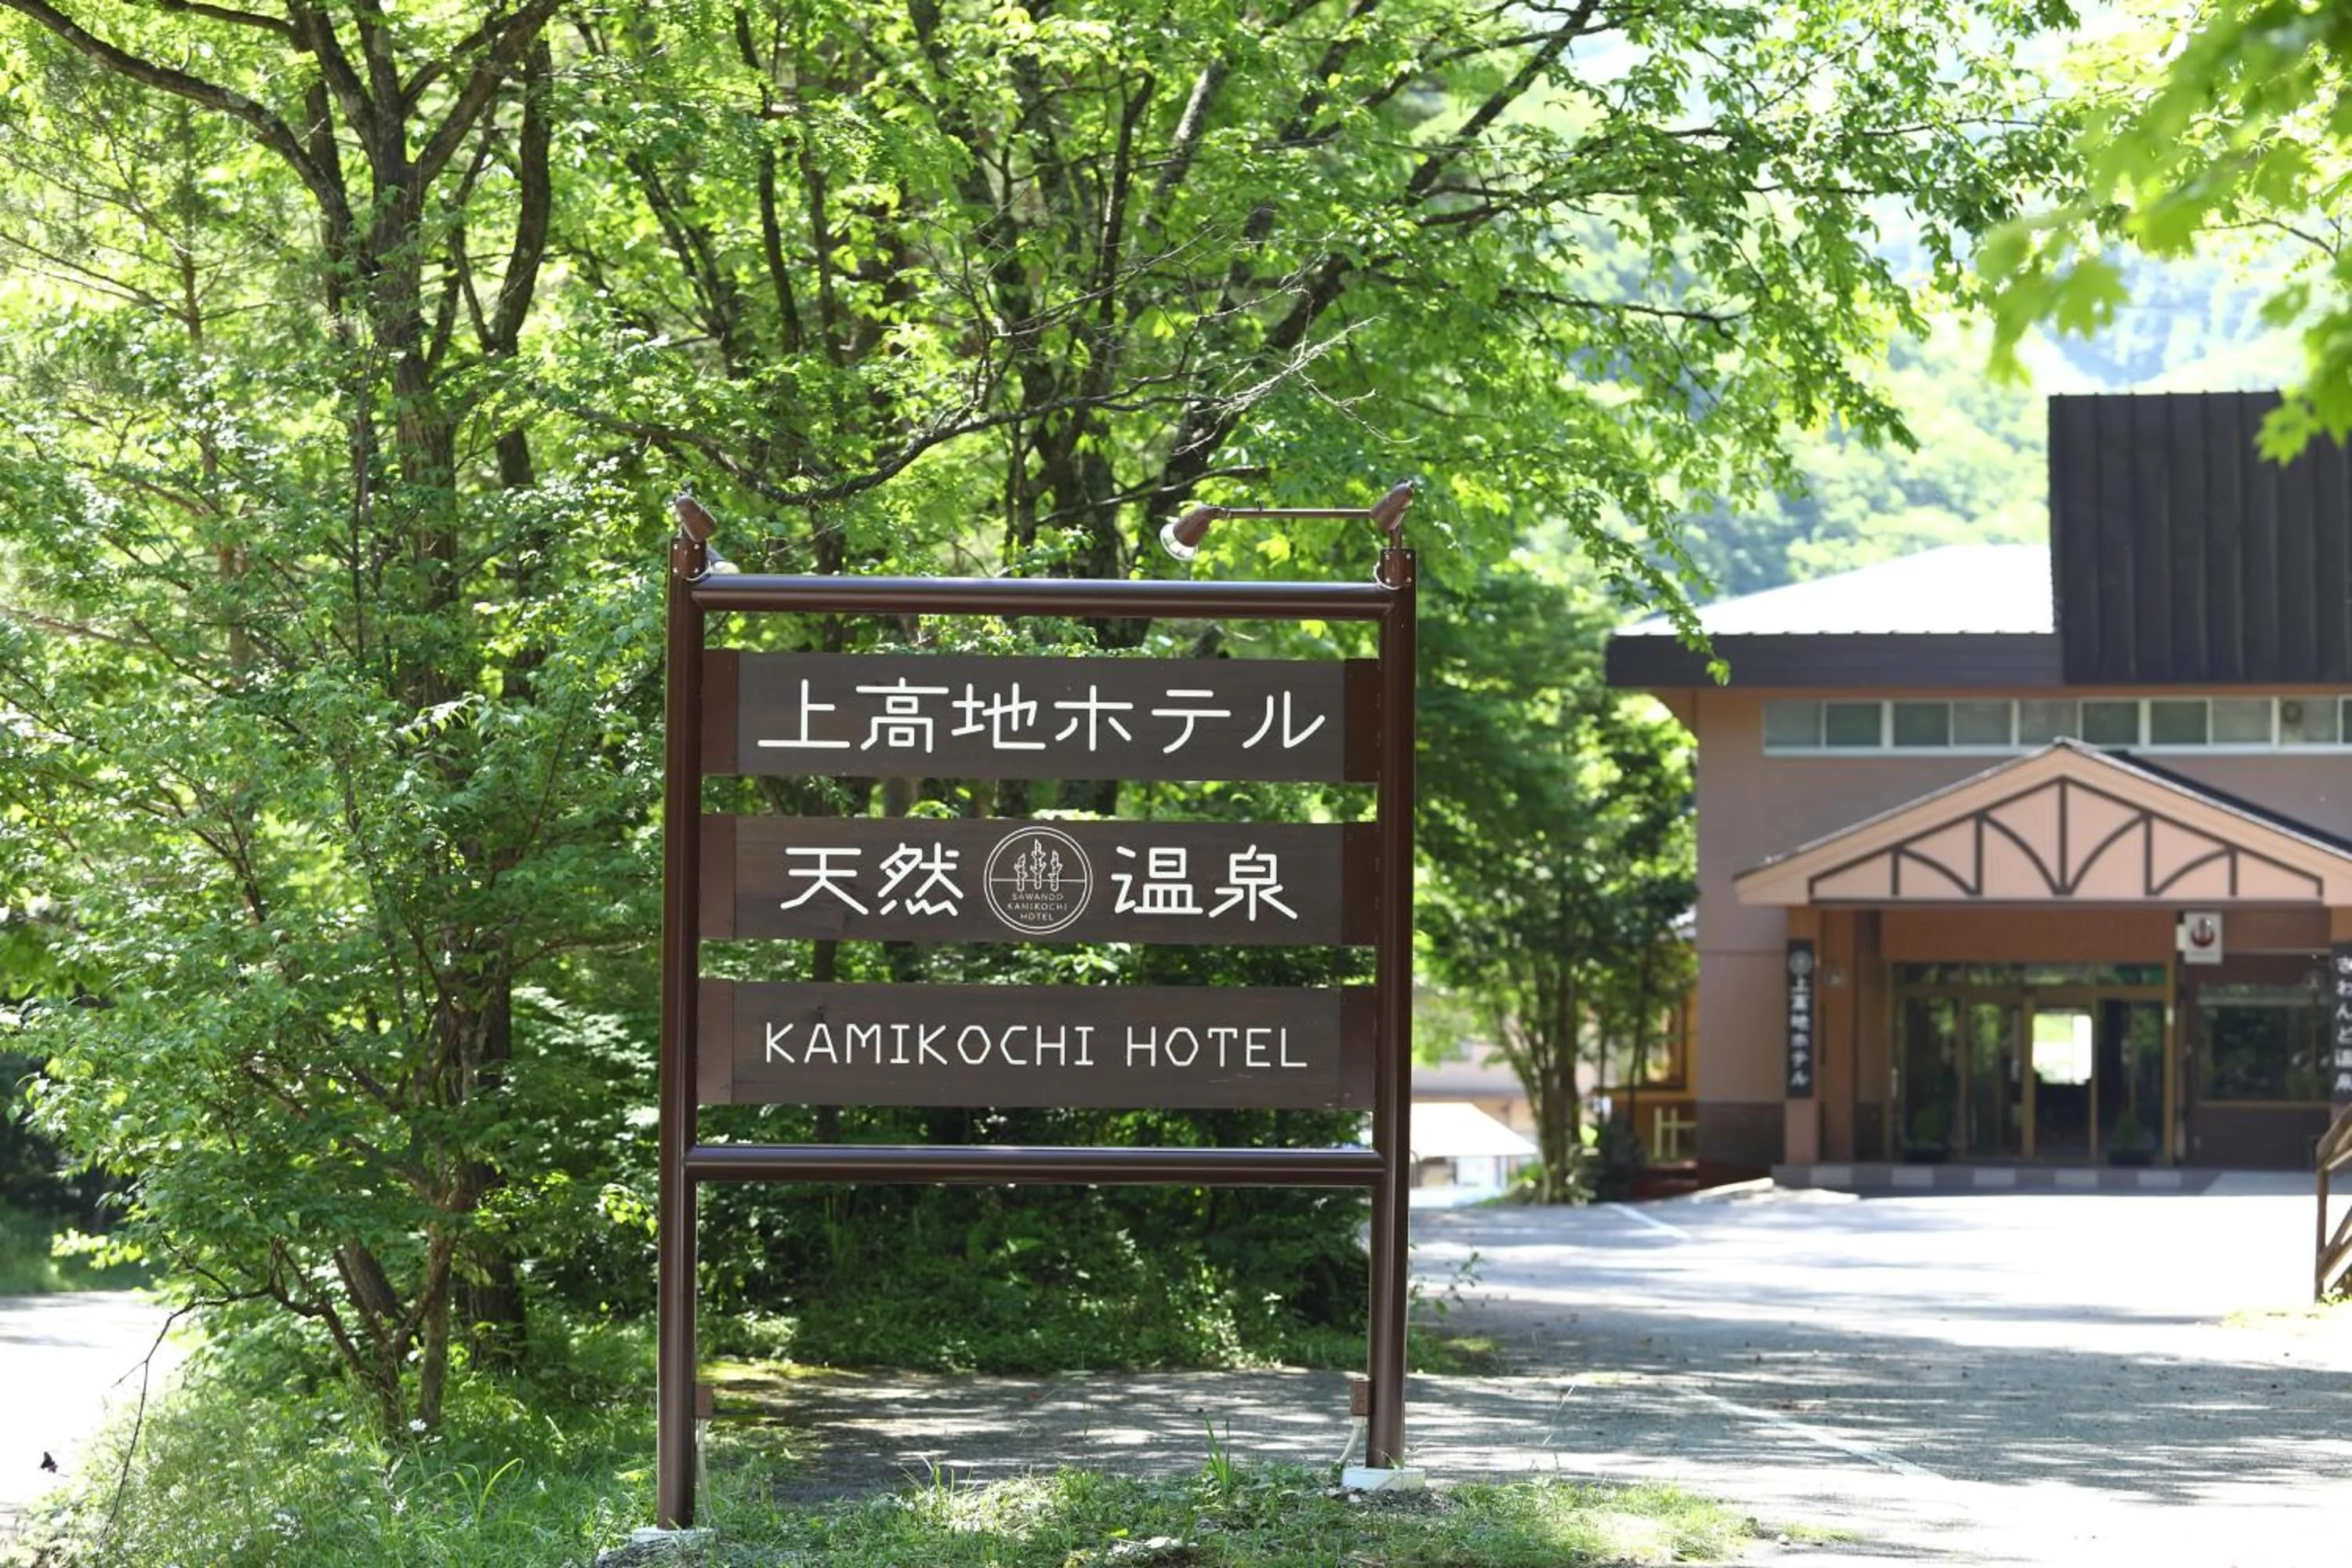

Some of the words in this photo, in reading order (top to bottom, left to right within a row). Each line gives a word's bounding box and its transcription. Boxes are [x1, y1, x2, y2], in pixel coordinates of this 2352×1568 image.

[757, 677, 1326, 753] 上高地ホテル
[780, 842, 964, 916] 天然
[1111, 844, 1298, 921] 温泉
[1007, 902, 1067, 911] KAMIKOCHI
[1020, 912, 1054, 921] HOTEL
[766, 1022, 1094, 1066] KAMIKOCHI
[1127, 1026, 1308, 1067] HOTEL
